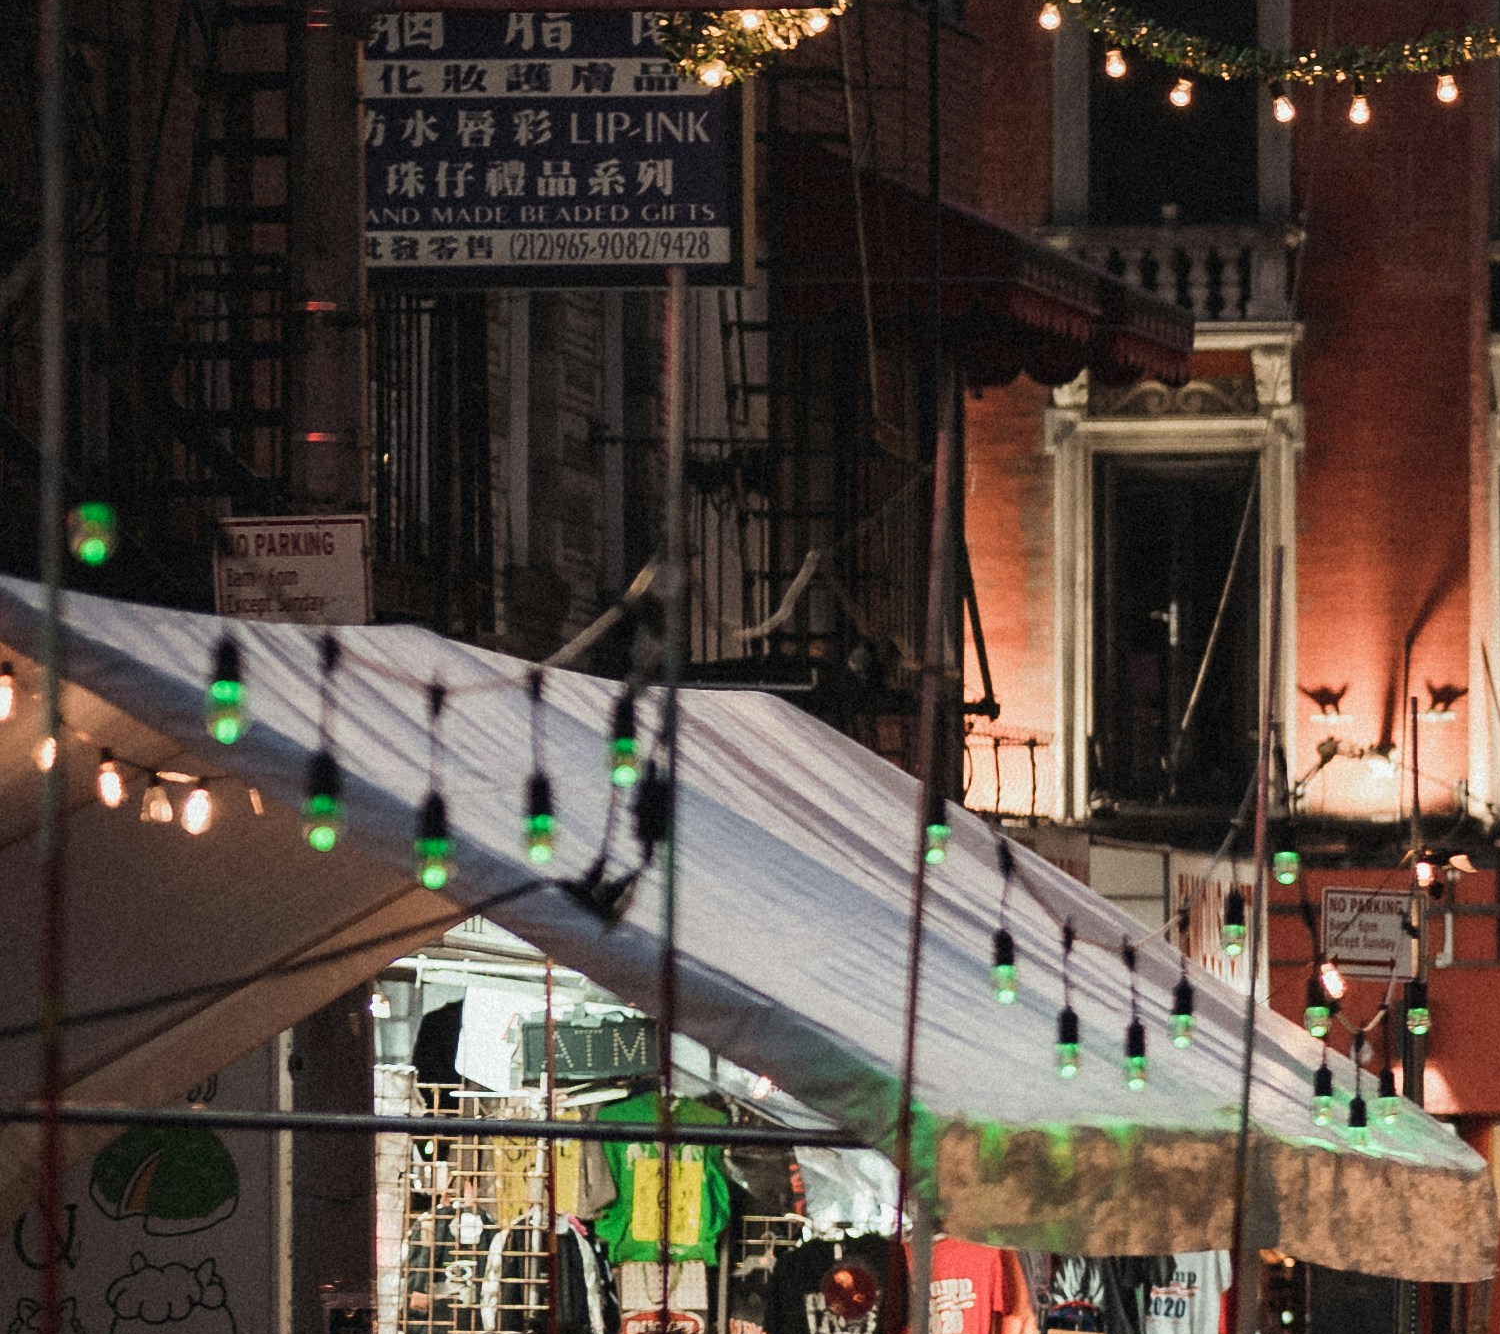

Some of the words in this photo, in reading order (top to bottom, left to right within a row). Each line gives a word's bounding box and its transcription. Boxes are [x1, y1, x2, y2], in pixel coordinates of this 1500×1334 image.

[570, 111, 711, 145] LIP-INK
[367, 208, 419, 224] AND
[432, 207, 507, 223] MADE
[520, 206, 629, 223] BEADED
[641, 204, 717, 222] GIFTS
[508, 232, 711, 261] (212)965-9082/9428
[255, 532, 335, 557] PARKING
[1329, 898, 1345, 914] NO
[1350, 898, 1404, 916] PARKING
[552, 1028, 648, 1069] ATM
